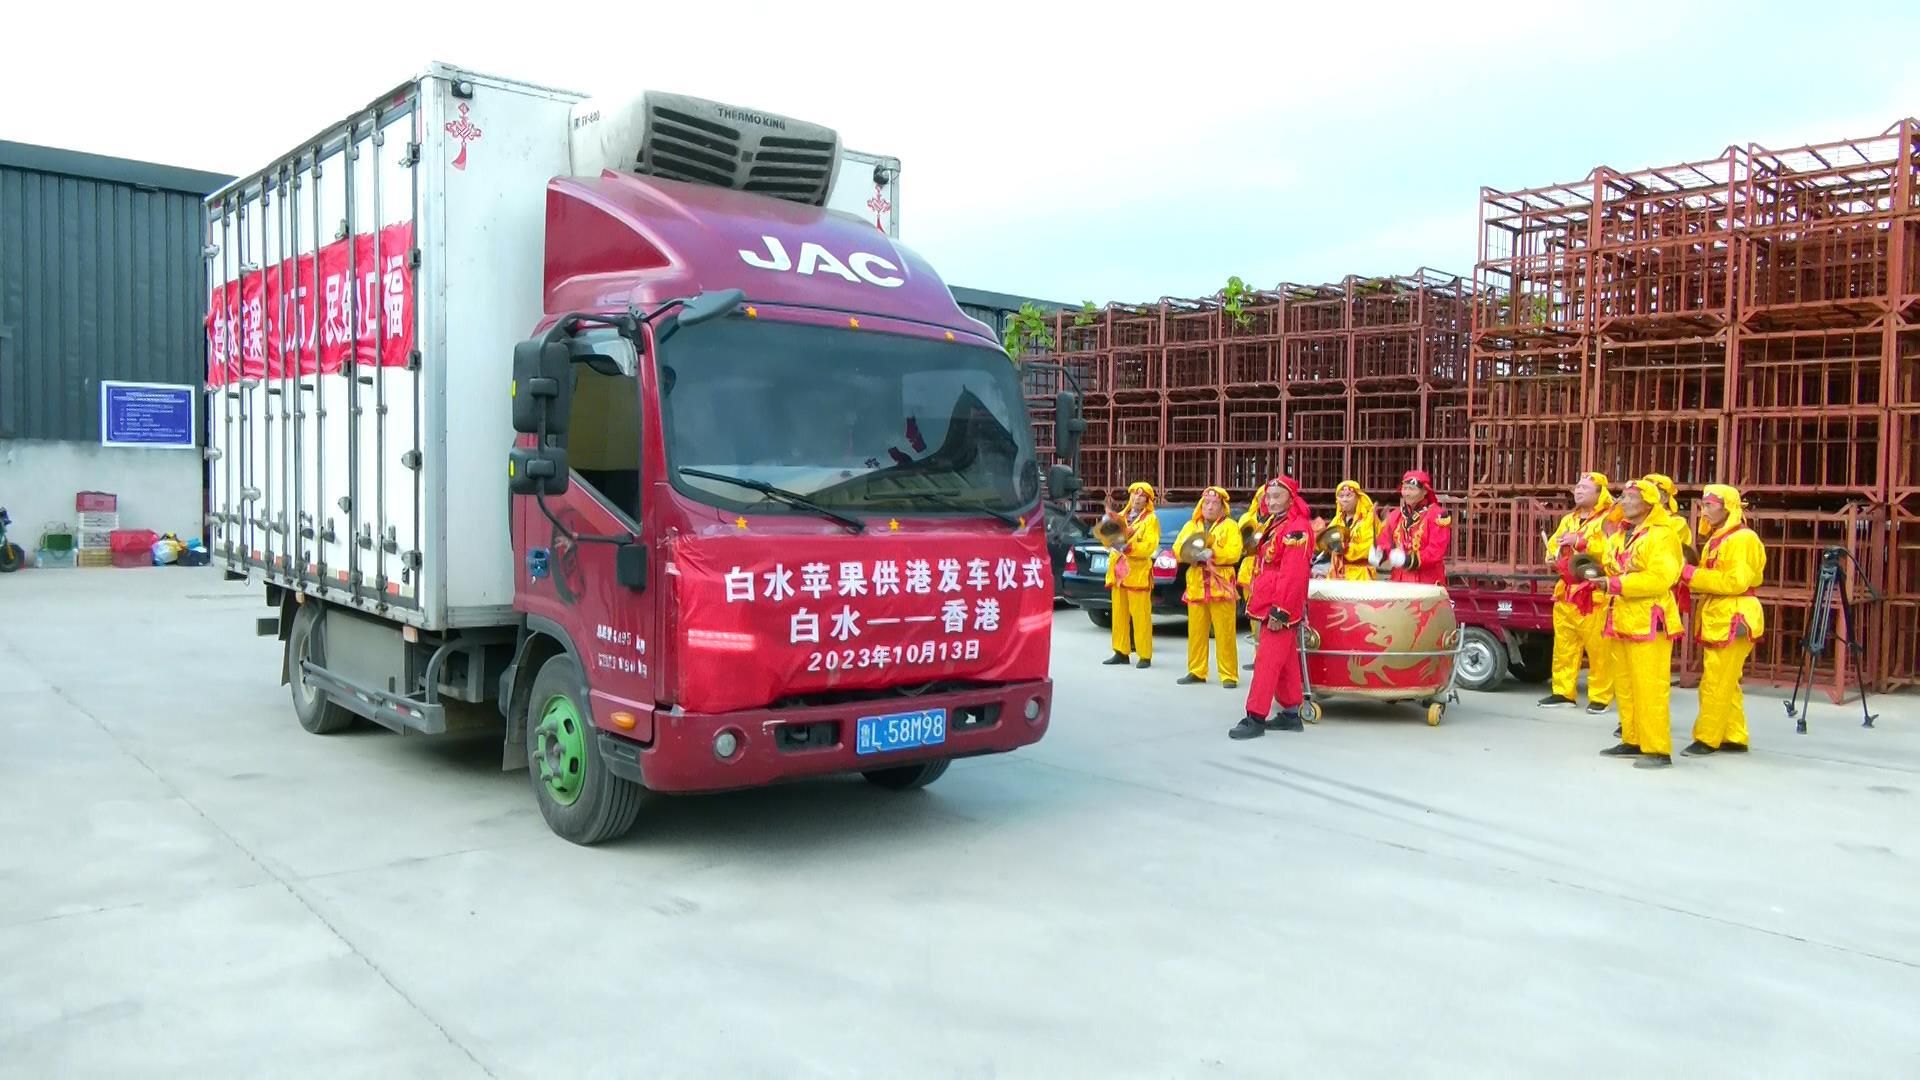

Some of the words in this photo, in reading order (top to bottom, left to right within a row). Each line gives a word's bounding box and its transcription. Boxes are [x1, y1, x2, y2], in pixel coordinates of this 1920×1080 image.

[718, 107, 761, 125] THERMO
[762, 117, 786, 131] KING
[738, 235, 905, 287] JAC
[724, 558, 1045, 603] 白水苹果供港发车仪式
[807, 640, 980, 672] 2023年10月13日
